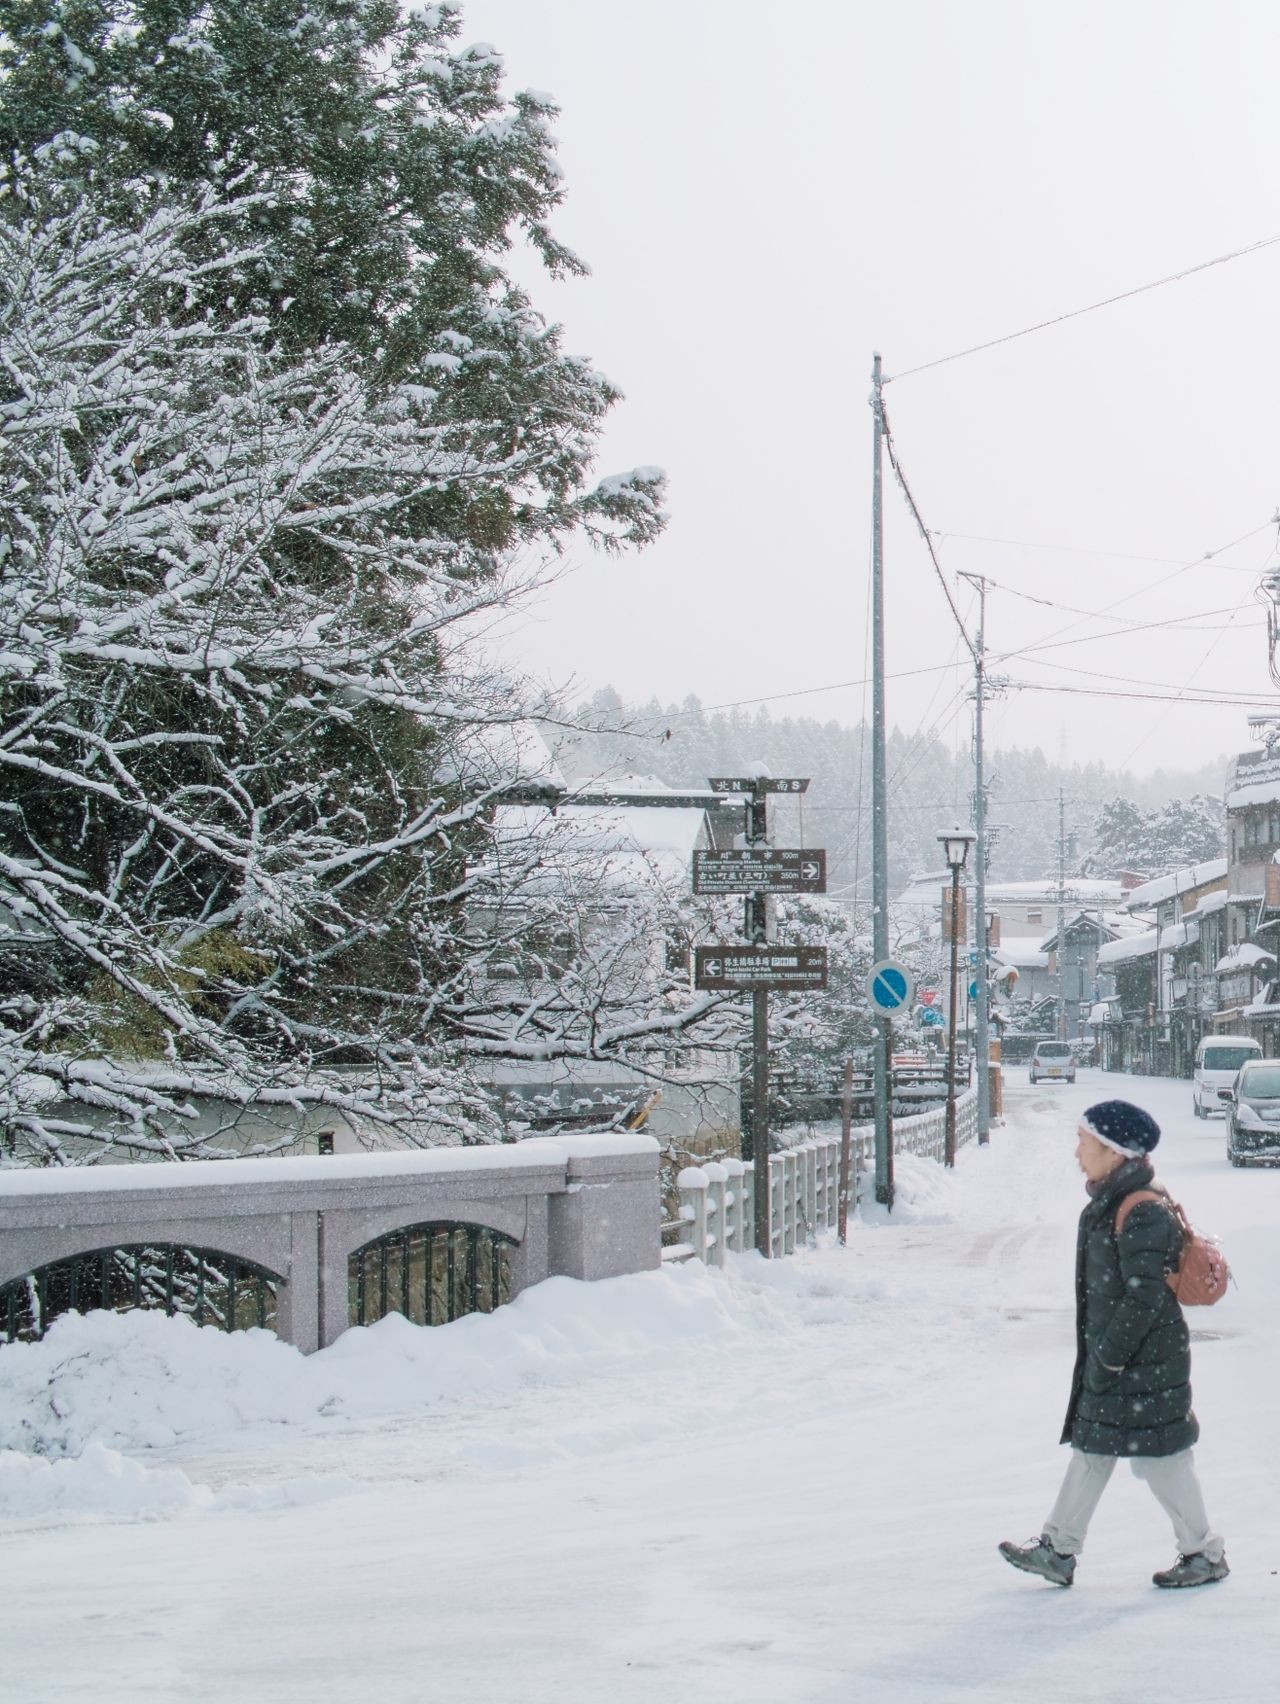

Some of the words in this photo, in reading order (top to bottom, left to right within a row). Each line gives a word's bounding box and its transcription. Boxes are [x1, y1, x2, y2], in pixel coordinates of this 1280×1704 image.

[717, 781, 729, 790] 北
[732, 781, 741, 790] N
[777, 780, 788, 791] 南
[791, 781, 800, 790] S
